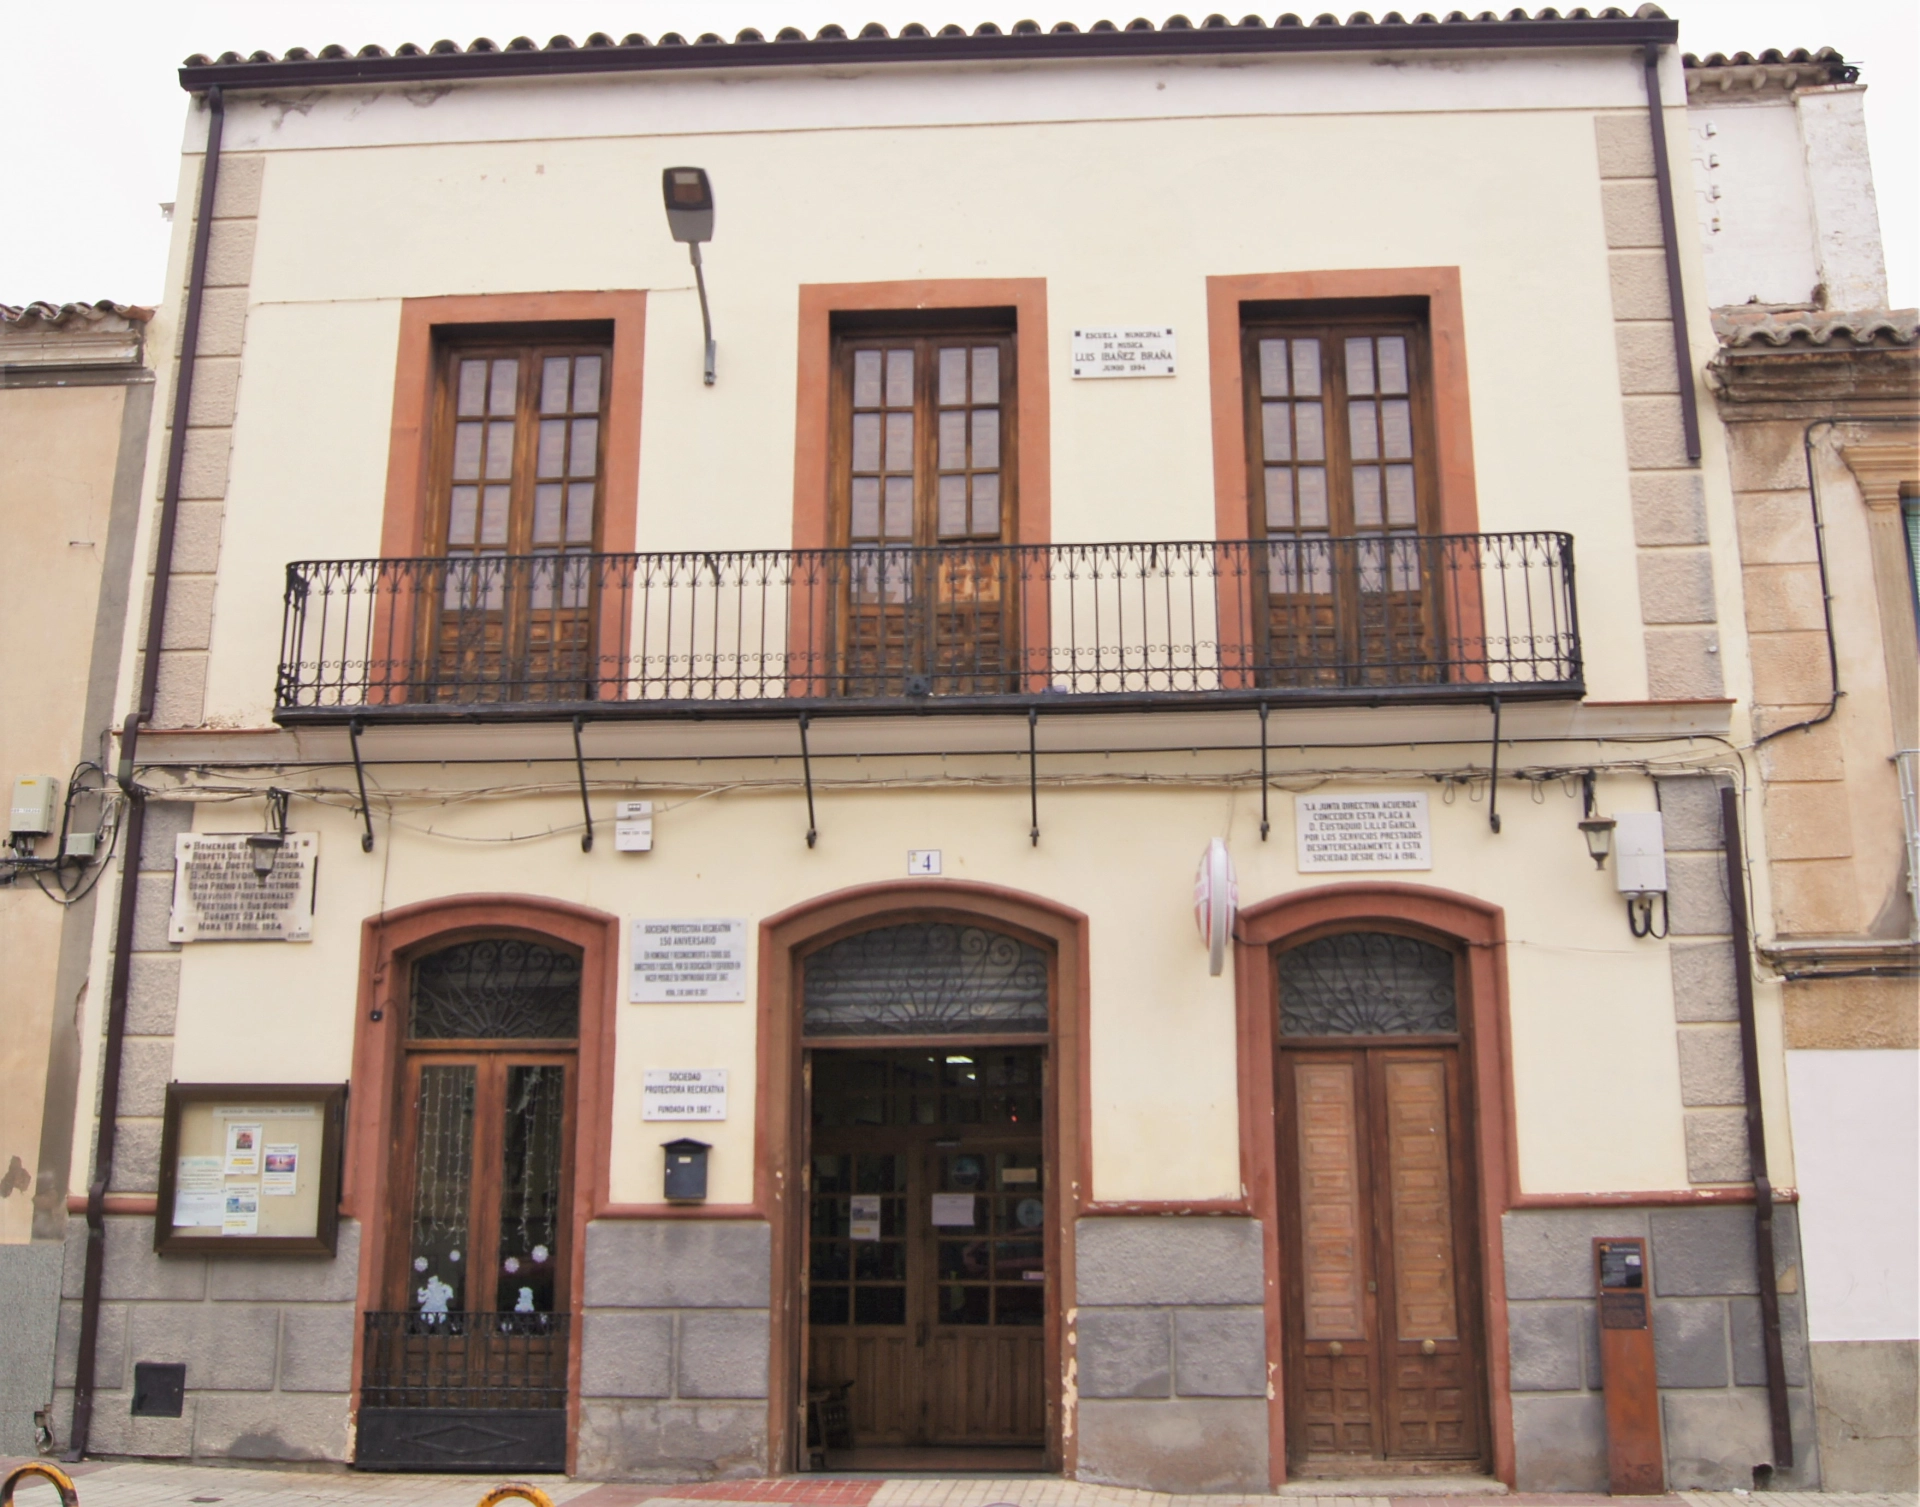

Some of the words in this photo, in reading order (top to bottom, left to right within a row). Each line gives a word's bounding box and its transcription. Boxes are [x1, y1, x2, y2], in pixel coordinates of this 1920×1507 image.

[1075, 352, 1095, 362] LUIS
[1141, 349, 1172, 360] BRAÑA
[1313, 812, 1354, 821] CONCEDER
[1356, 812, 1376, 820] ESTA
[1378, 811, 1404, 819] PLACA
[1406, 811, 1411, 819] A
[1320, 821, 1362, 831] EUSTAQUIO
[1304, 833, 1319, 841] POR
[1321, 833, 1336, 841] LOS
[1339, 832, 1378, 840] SERVICIOS
[1380, 831, 1422, 839] PRESTADOS
[1395, 842, 1400, 850] A
[1402, 841, 1421, 850] ESTA
[1313, 853, 1348, 862] SOCIEDAD
[1350, 852, 1374, 861] DESDE
[1394, 852, 1399, 860] A
[922, 854, 931, 871] 4
[660, 937, 672, 946] 150
[673, 936, 716, 945] ANIVERSARIO
[669, 1072, 702, 1081] SOCIEDAD
[645, 1085, 685, 1094] PROTECTORA
[687, 1084, 724, 1094] RECREATIVA
[657, 1105, 685, 1113] FUNDADA
[687, 1105, 695, 1113] EN
